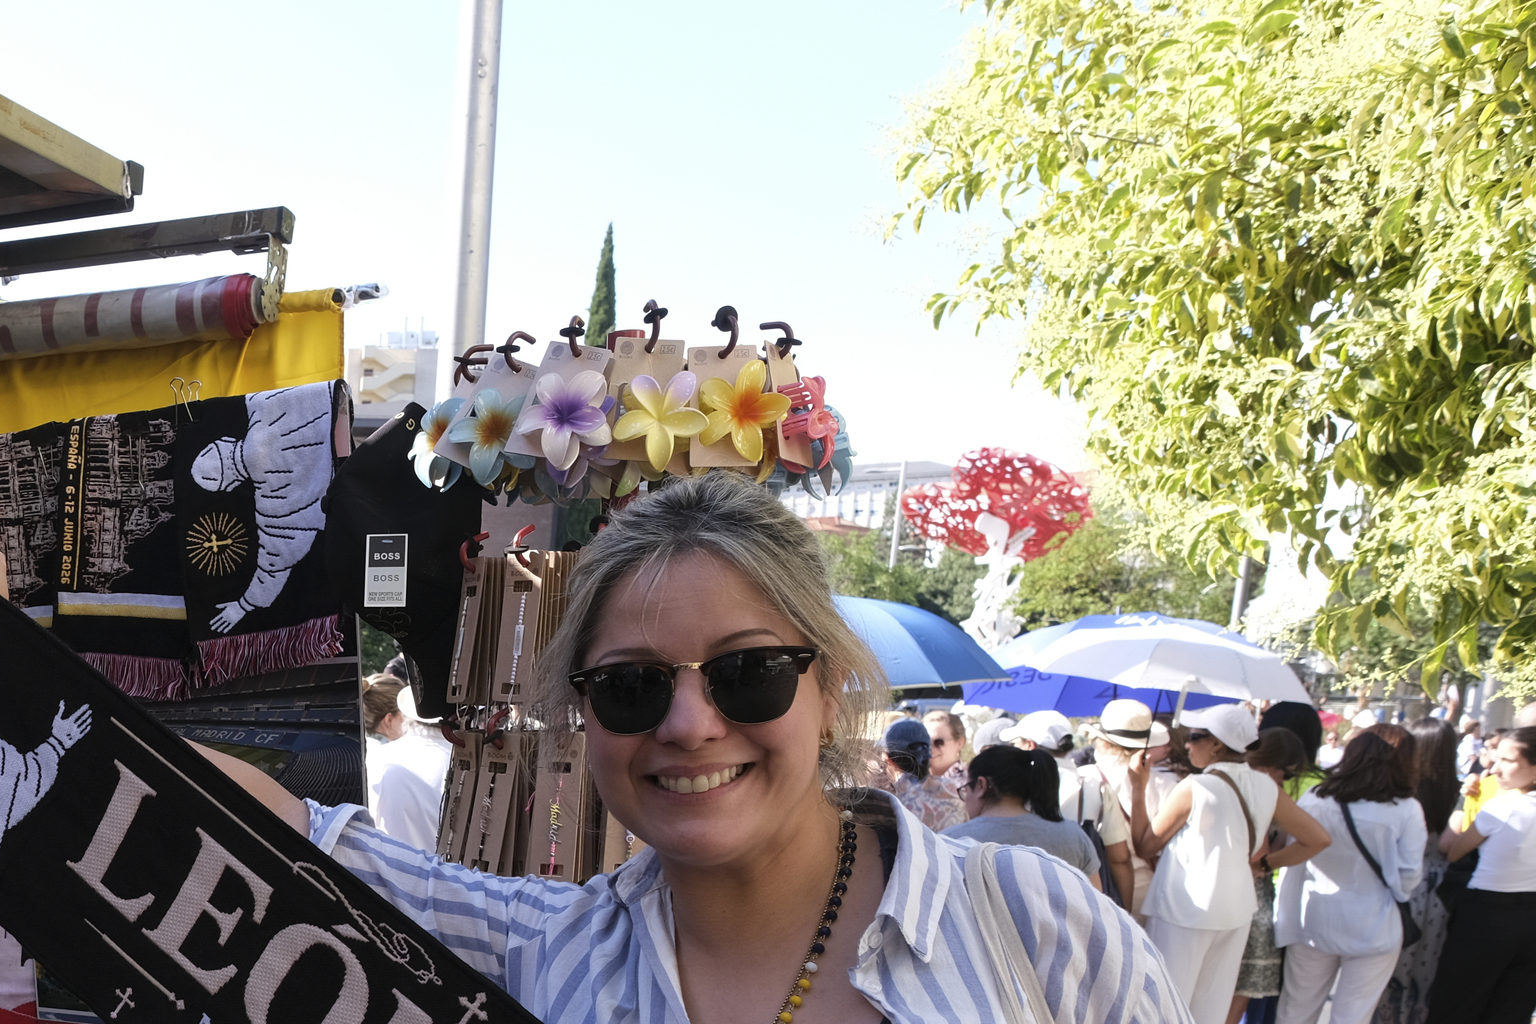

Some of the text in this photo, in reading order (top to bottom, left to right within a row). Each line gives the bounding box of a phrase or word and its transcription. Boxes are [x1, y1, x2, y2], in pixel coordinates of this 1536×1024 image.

[67, 425, 83, 470] ESPAÑA
[65, 485, 76, 514] 6-12
[63, 518, 75, 551] JUNIO
[60, 556, 72, 585] 2026
[373, 552, 401, 561] BOSS
[373, 574, 400, 582] BOSS
[191, 729, 246, 741] MADRID
[254, 733, 280, 744] CF
[549, 799, 562, 844] Madrid
